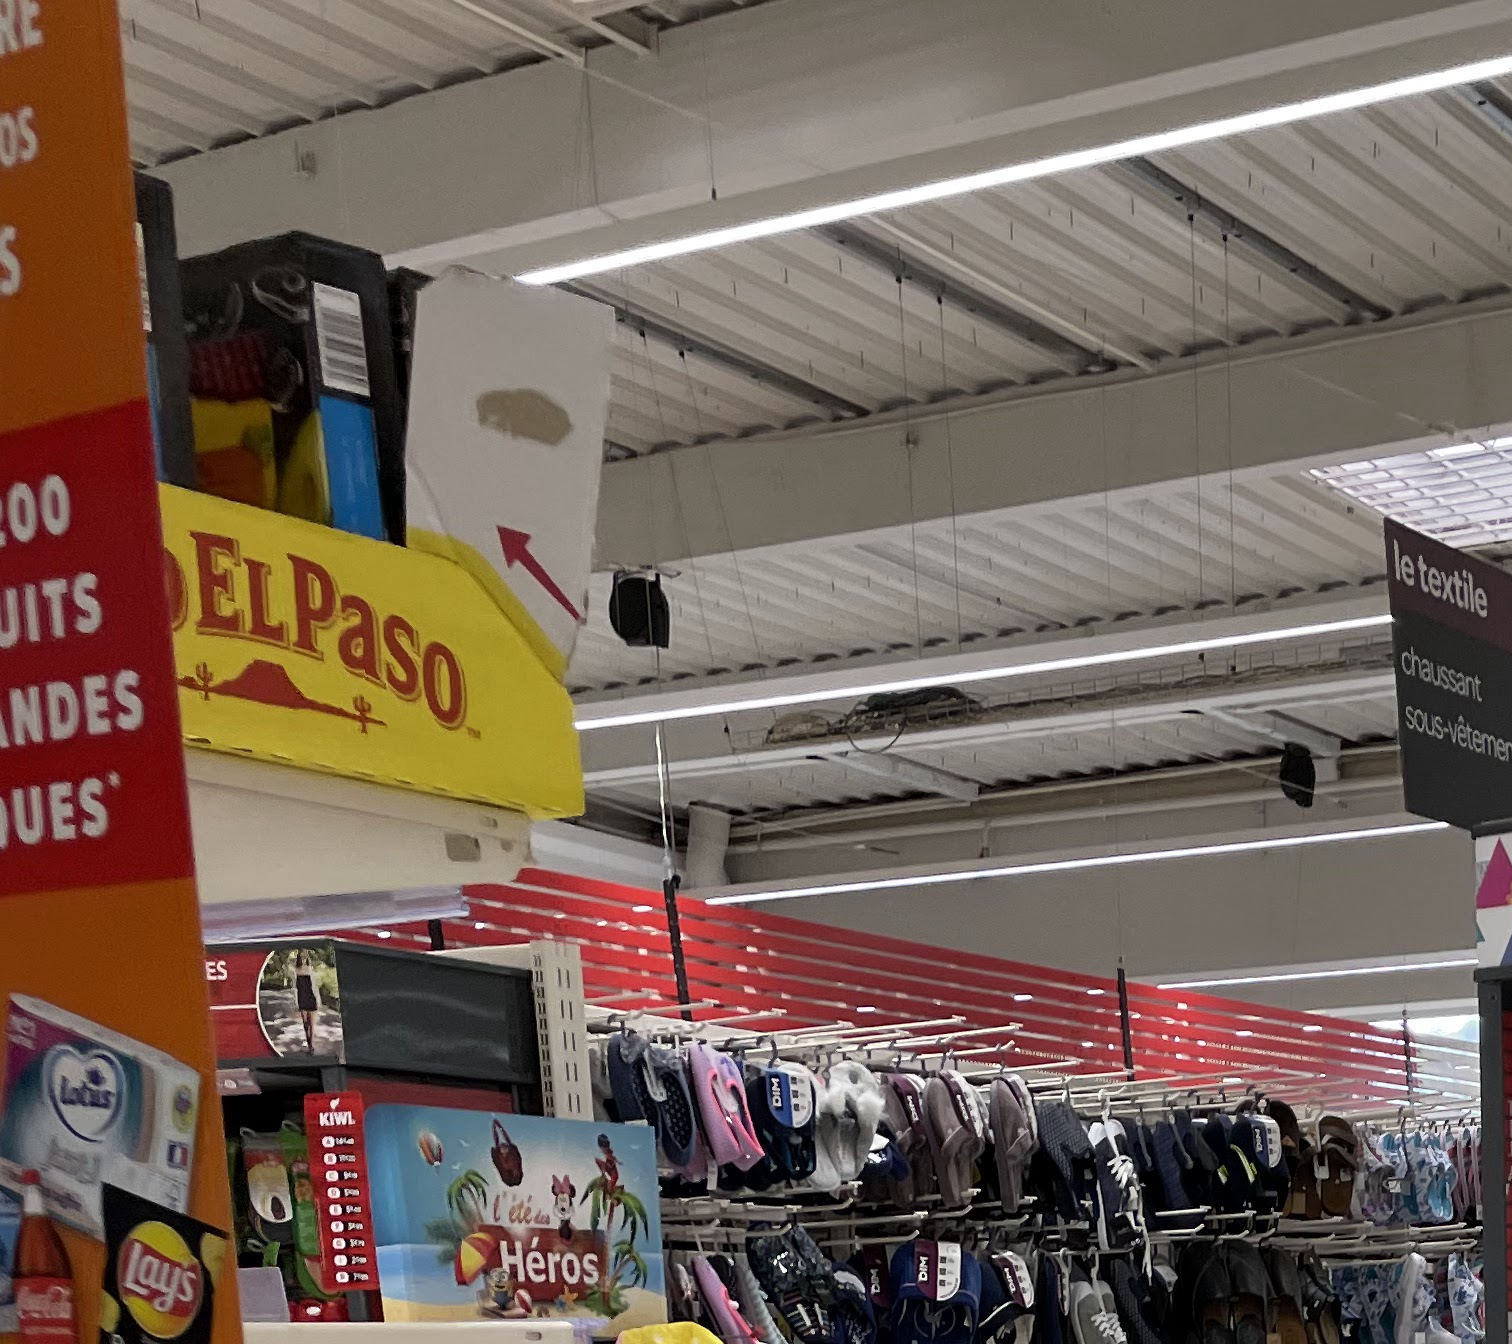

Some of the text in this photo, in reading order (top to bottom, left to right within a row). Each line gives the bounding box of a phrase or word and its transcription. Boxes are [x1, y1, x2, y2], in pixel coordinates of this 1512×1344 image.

[0, 474, 71, 547] 00
[1393, 539, 1488, 618] le textile
[1401, 646, 1483, 702] chaussant
[0, 669, 144, 749] NDES
[770, 1077, 783, 1108] DIM
[500, 1236, 600, 1285] Héros
[918, 1256, 929, 1282] DIM
